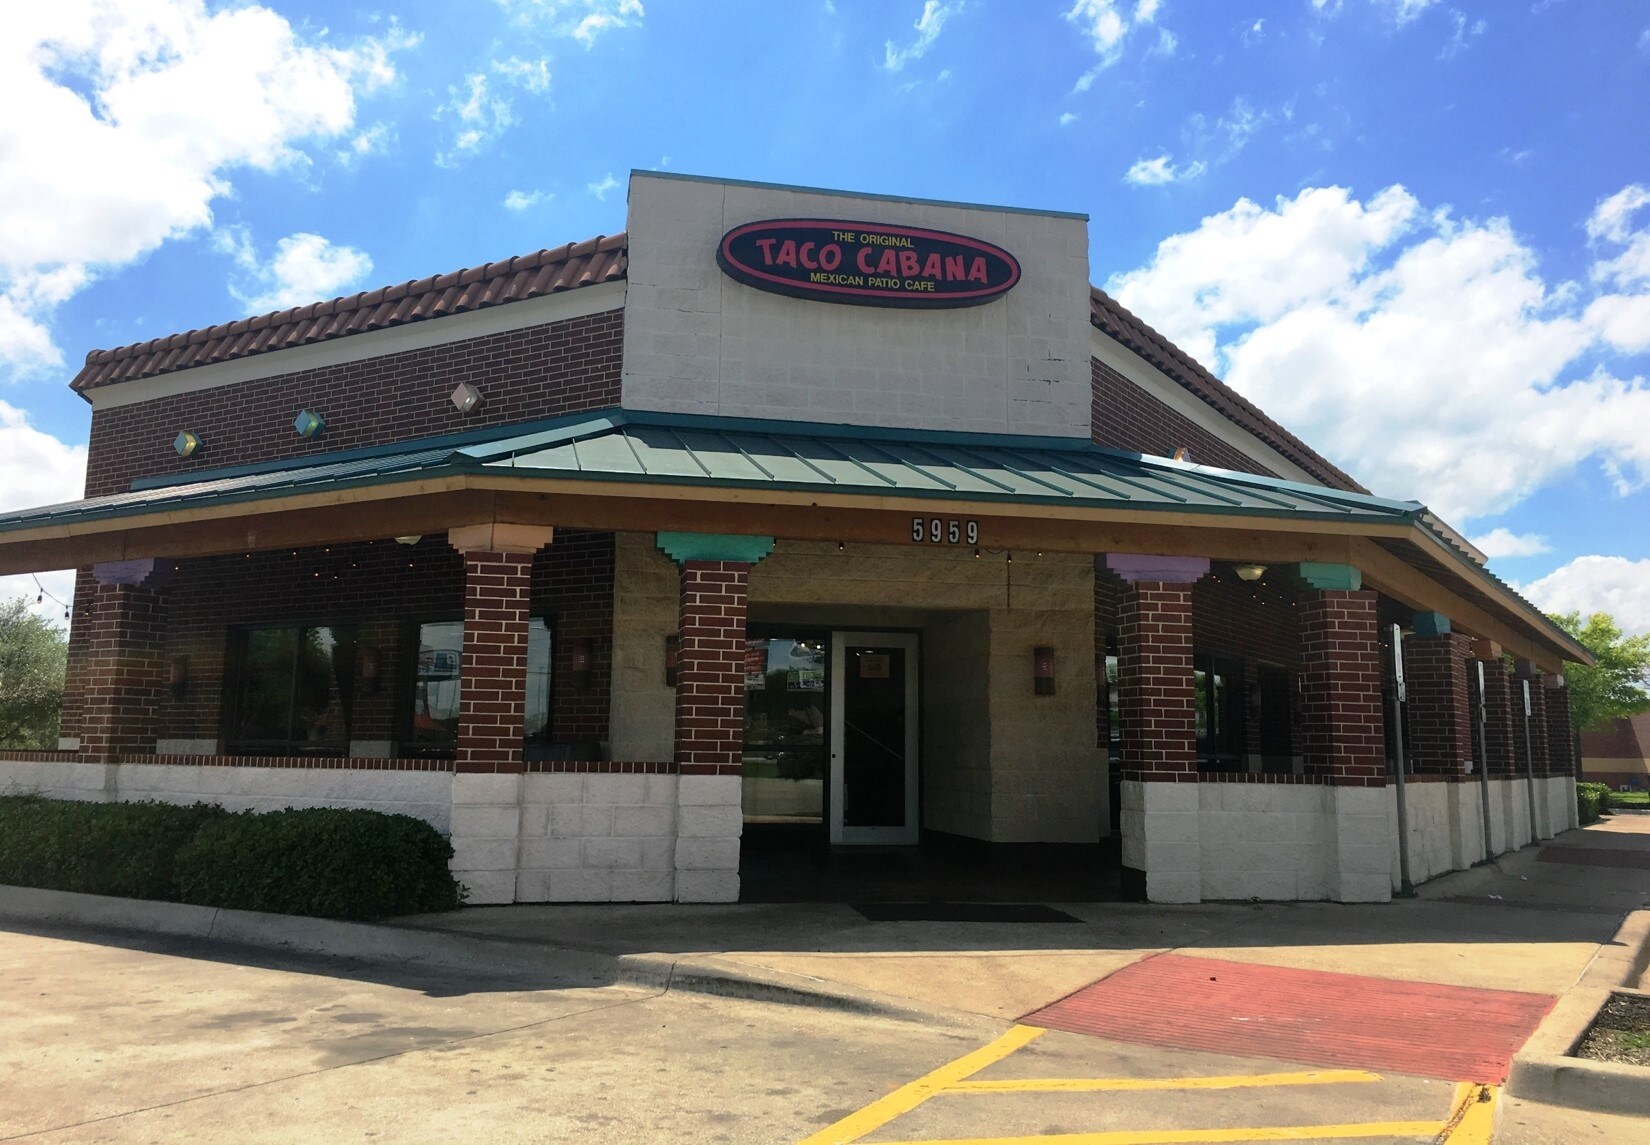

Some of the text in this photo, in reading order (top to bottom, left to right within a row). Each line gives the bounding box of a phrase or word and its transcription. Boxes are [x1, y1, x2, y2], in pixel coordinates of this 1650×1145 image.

[832, 231, 914, 248] THE ORIGINAL
[756, 238, 988, 284] TACO CABANA
[810, 272, 935, 292] MEXICAN PATIO CAFE
[912, 518, 978, 544] 5959
